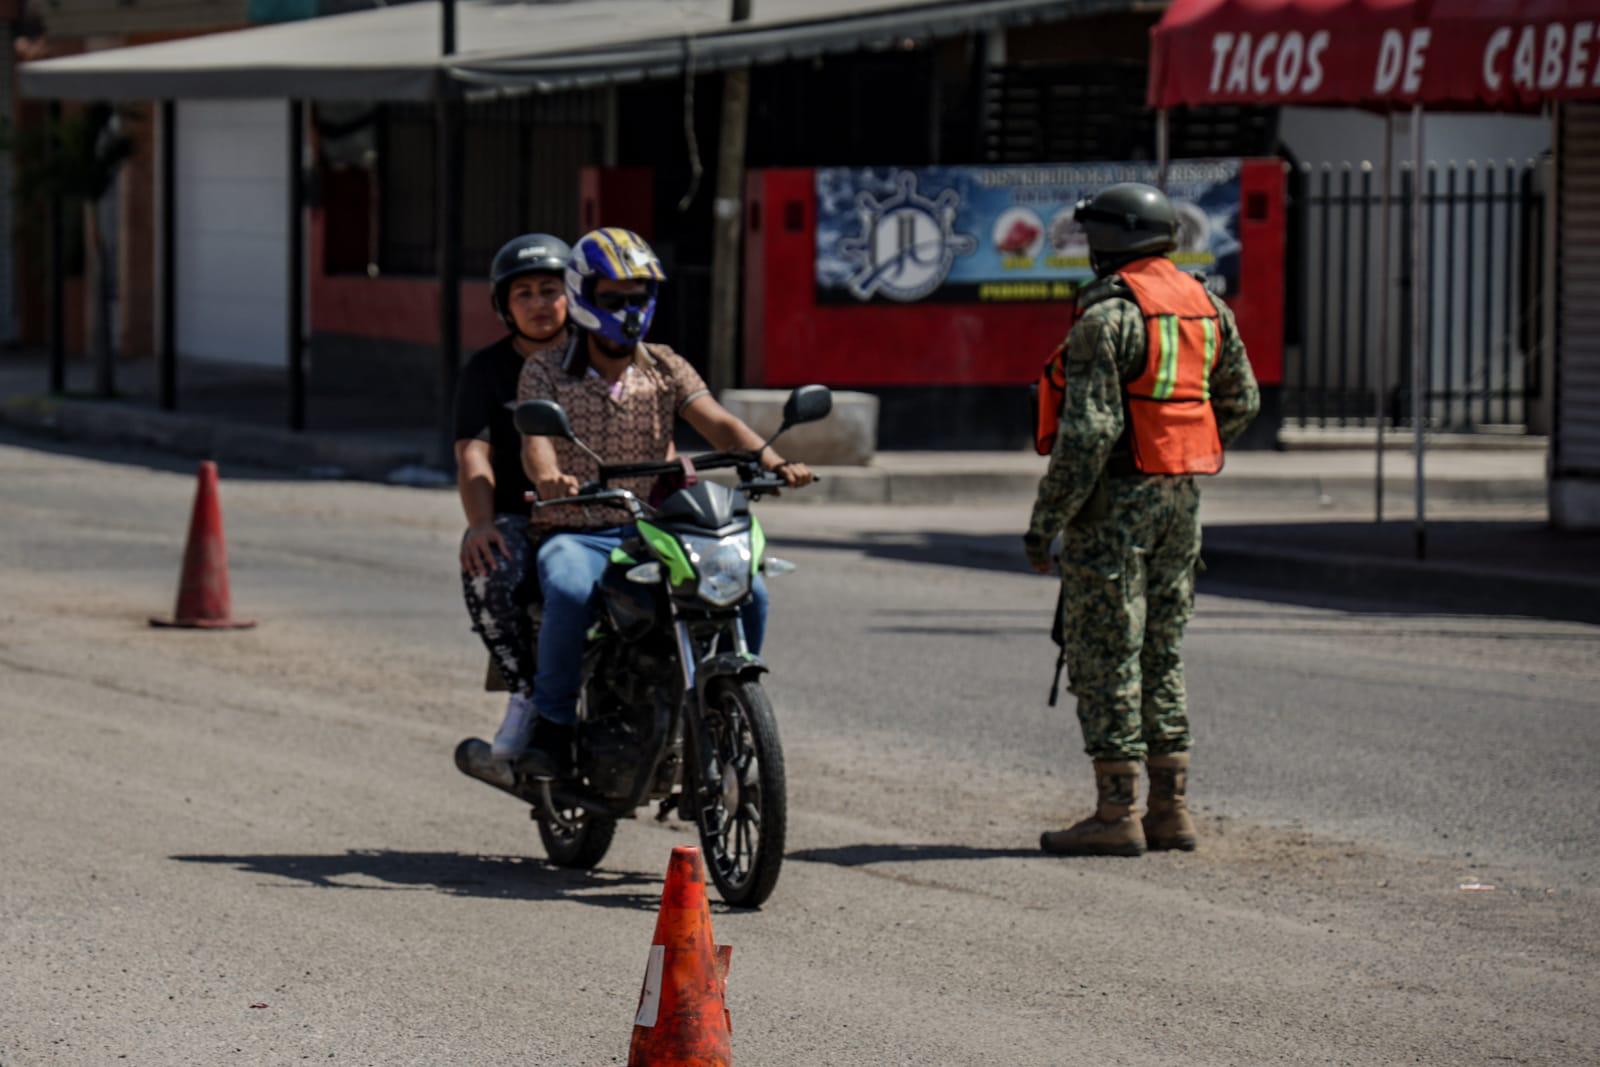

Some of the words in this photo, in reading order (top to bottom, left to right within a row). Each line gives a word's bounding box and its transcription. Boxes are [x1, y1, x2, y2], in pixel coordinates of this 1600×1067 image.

[1208, 30, 1330, 95] TACOS
[1373, 27, 1432, 95] DE
[1482, 20, 1600, 91] CABE
